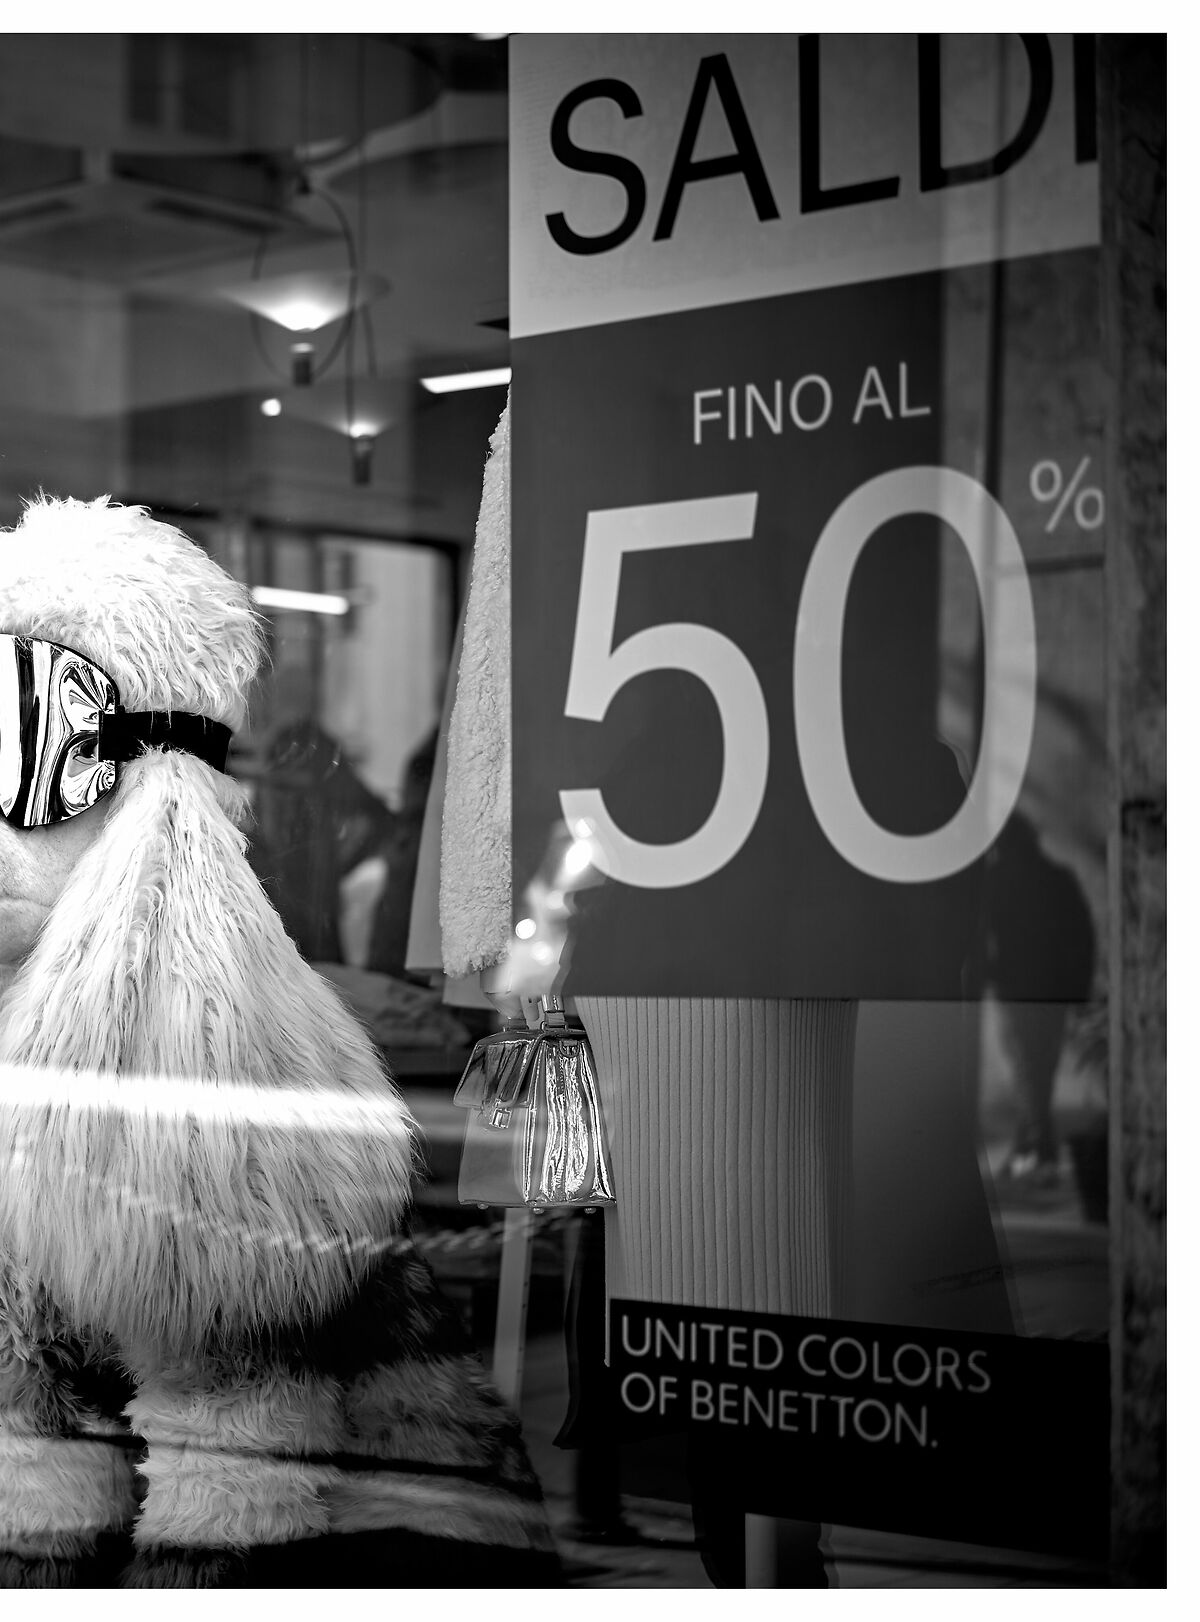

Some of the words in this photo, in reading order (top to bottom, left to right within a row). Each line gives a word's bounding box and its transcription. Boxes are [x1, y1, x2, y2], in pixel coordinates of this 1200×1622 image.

[546, 33, 1098, 256] SALDI
[693, 373, 834, 445] FINO
[851, 361, 932, 425] AL
[620, 1314, 785, 1371] UNITED
[798, 1334, 992, 1394] COLORS
[620, 1371, 679, 1417] OF
[690, 1378, 940, 1449] BENETTON.
